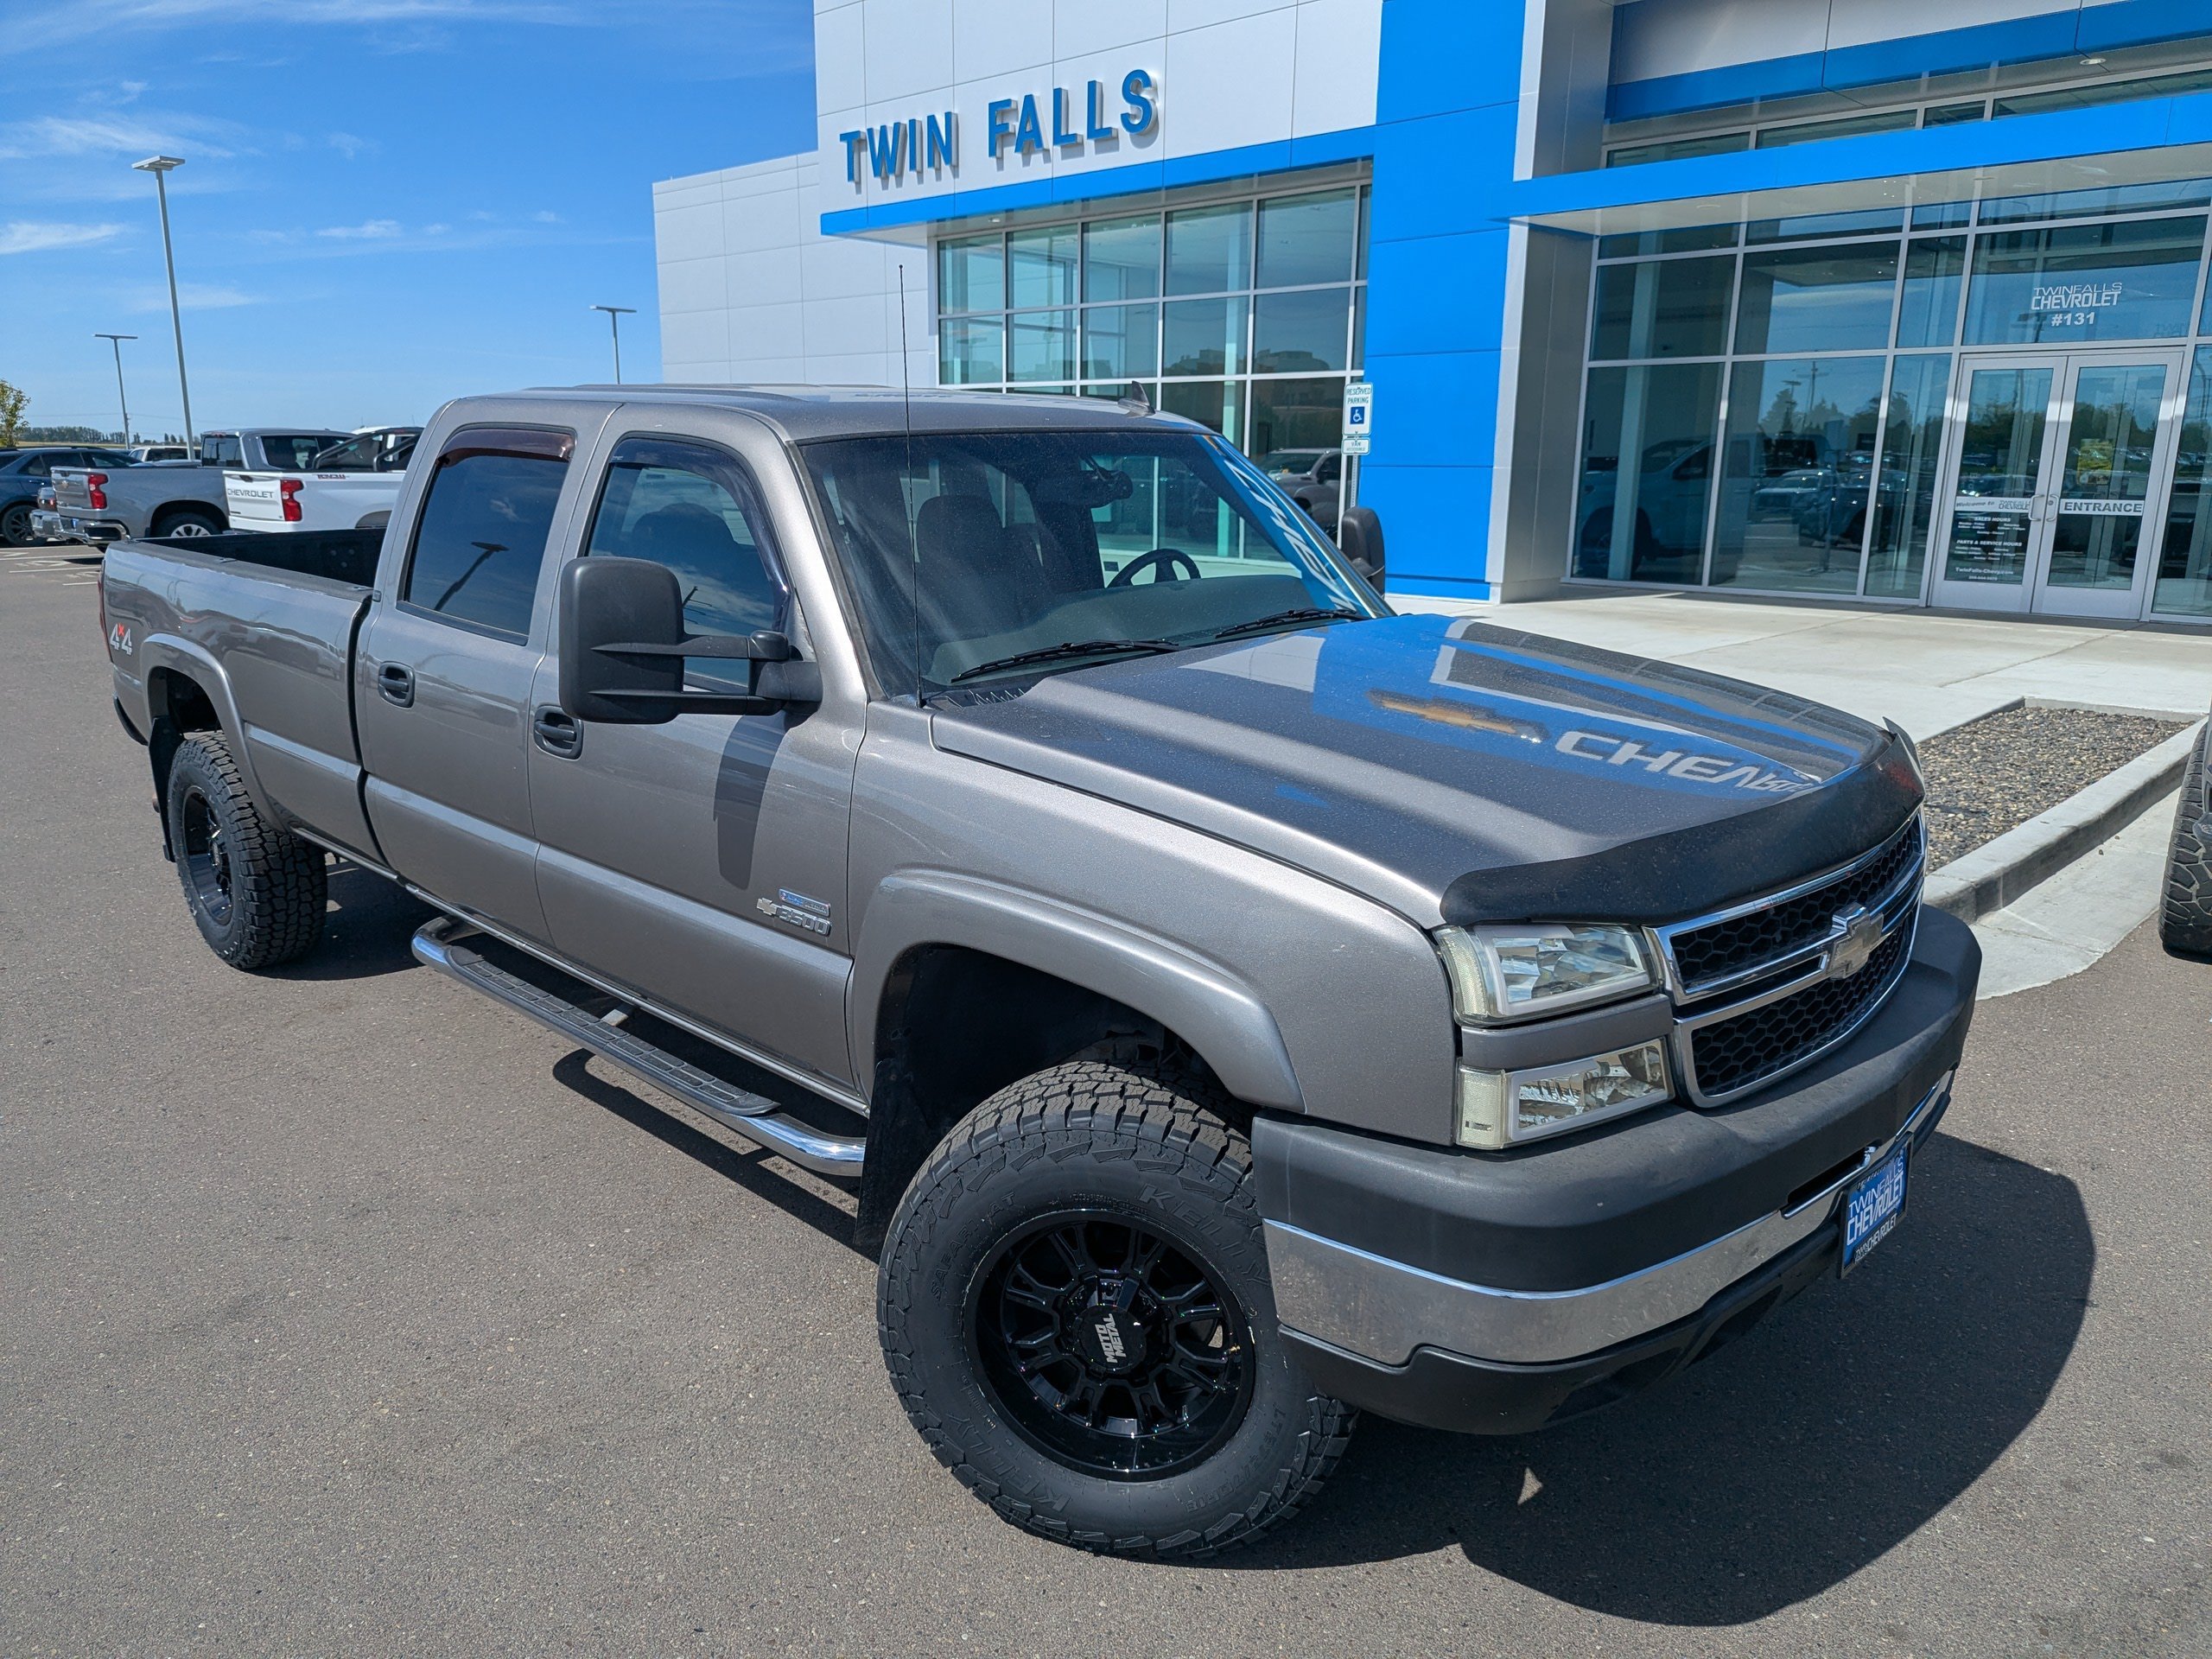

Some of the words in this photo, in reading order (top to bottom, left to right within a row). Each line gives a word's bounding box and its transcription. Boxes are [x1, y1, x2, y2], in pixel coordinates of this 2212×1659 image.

[839, 111, 957, 183] TWIN
[988, 69, 1158, 159] FALLS
[2031, 291, 2121, 310] CHEVROLET
[2033, 282, 2123, 296] TWINFALLS
[2051, 312, 2095, 327] #131
[227, 488, 274, 499] CHEVROLET
[2063, 502, 2143, 512] ENTRANCE
[1848, 1158, 1904, 1217] TWINFALLS
[1847, 1170, 1904, 1245] CHEVROLET
[1095, 1324, 1118, 1363] MOTO
[1103, 1313, 1127, 1357] METAL
